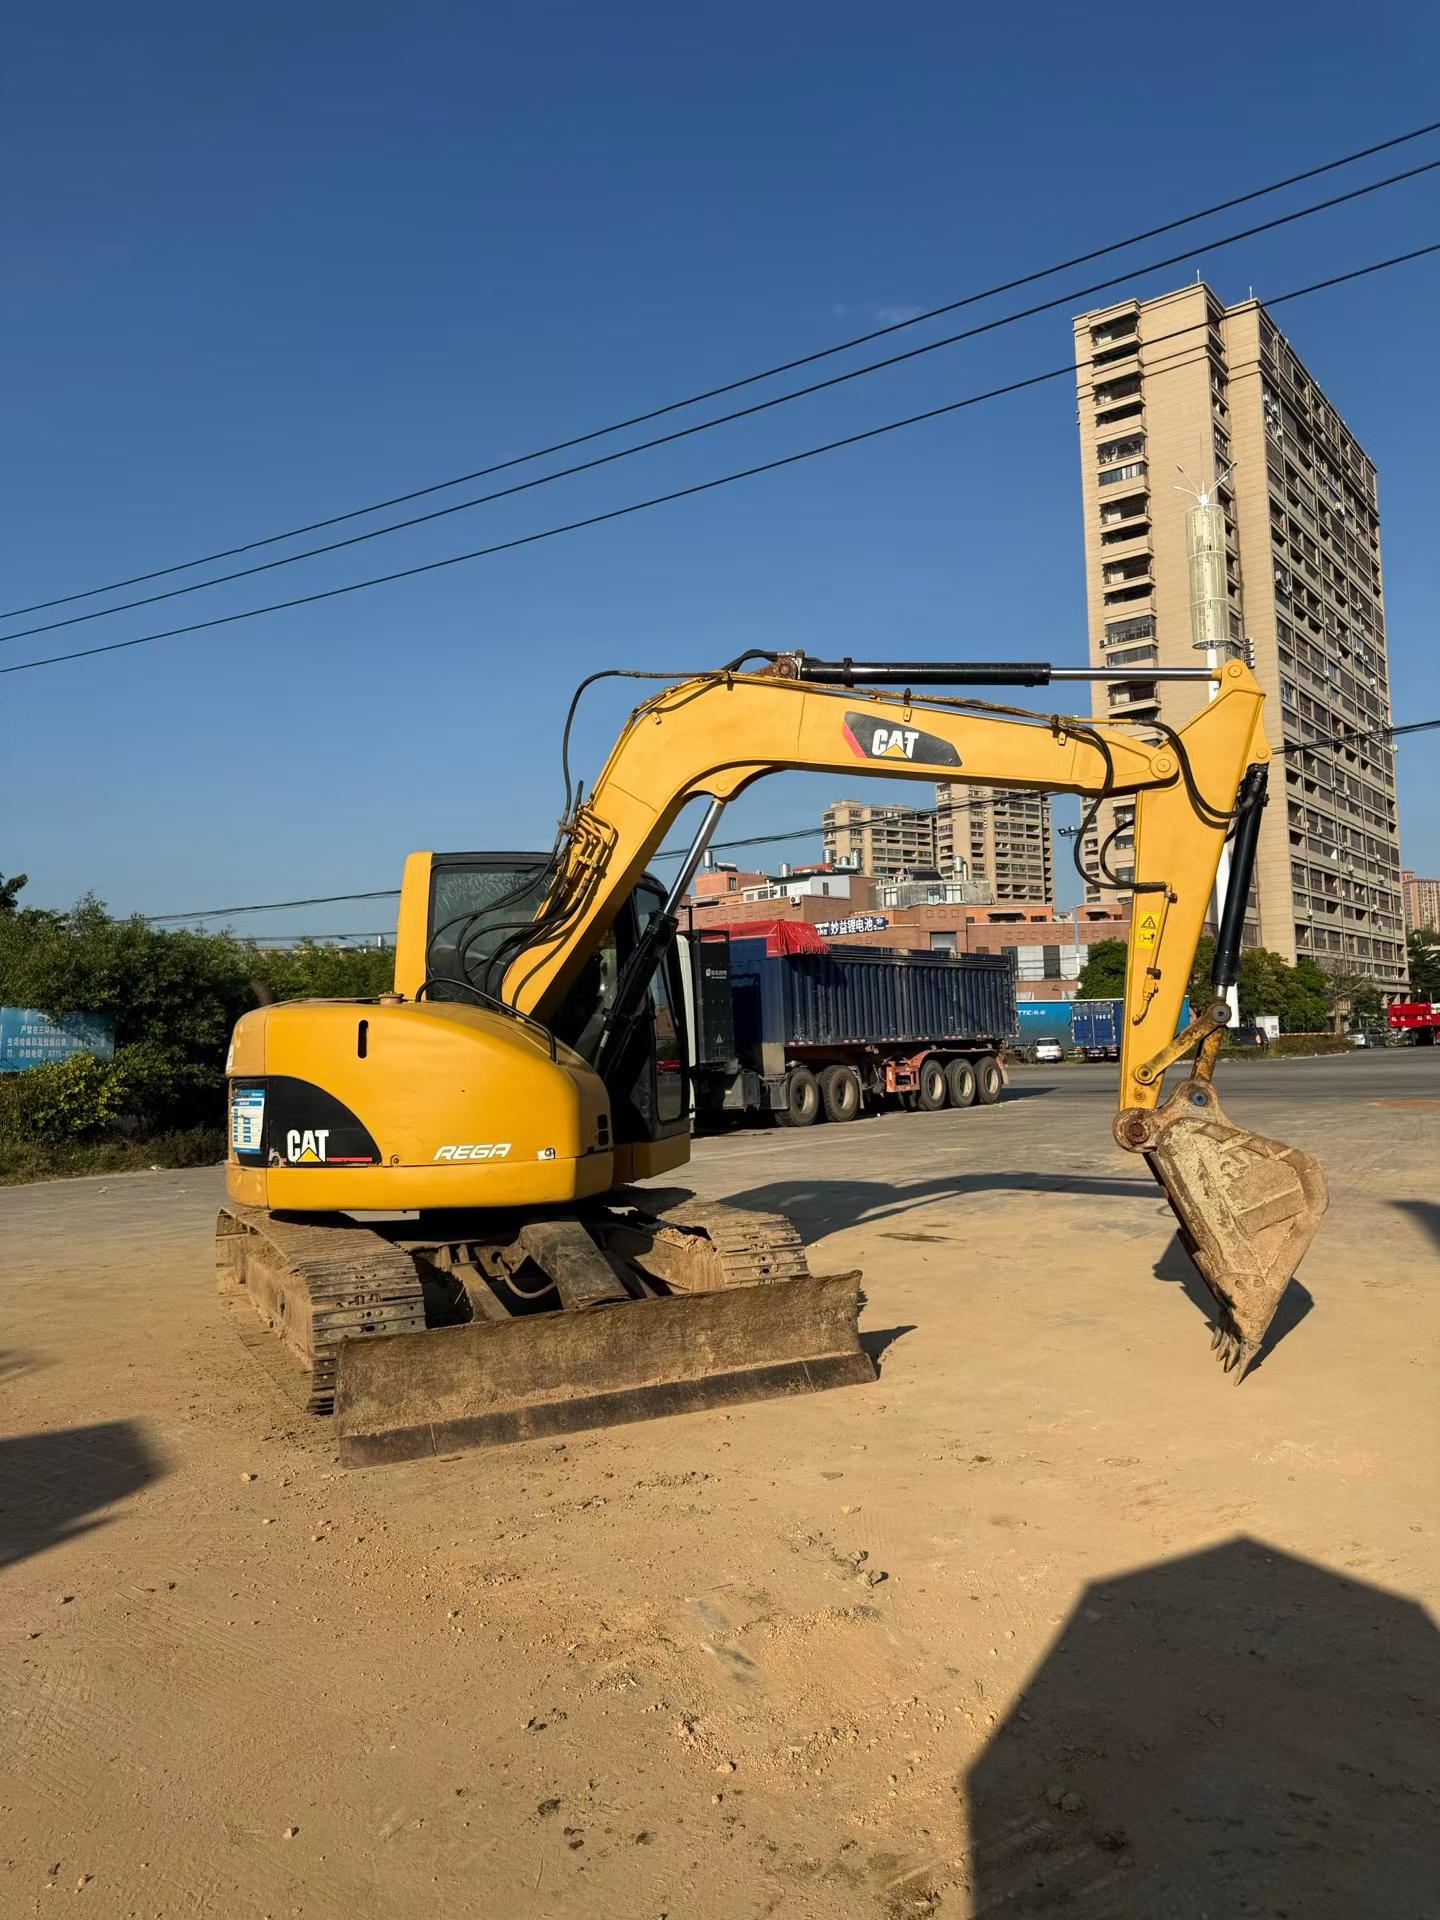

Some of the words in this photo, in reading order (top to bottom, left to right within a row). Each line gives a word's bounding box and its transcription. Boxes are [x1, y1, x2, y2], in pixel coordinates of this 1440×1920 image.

[871, 729, 919, 759] CAT
[287, 1129, 329, 1163] CAT
[433, 1143, 511, 1161] REGA
